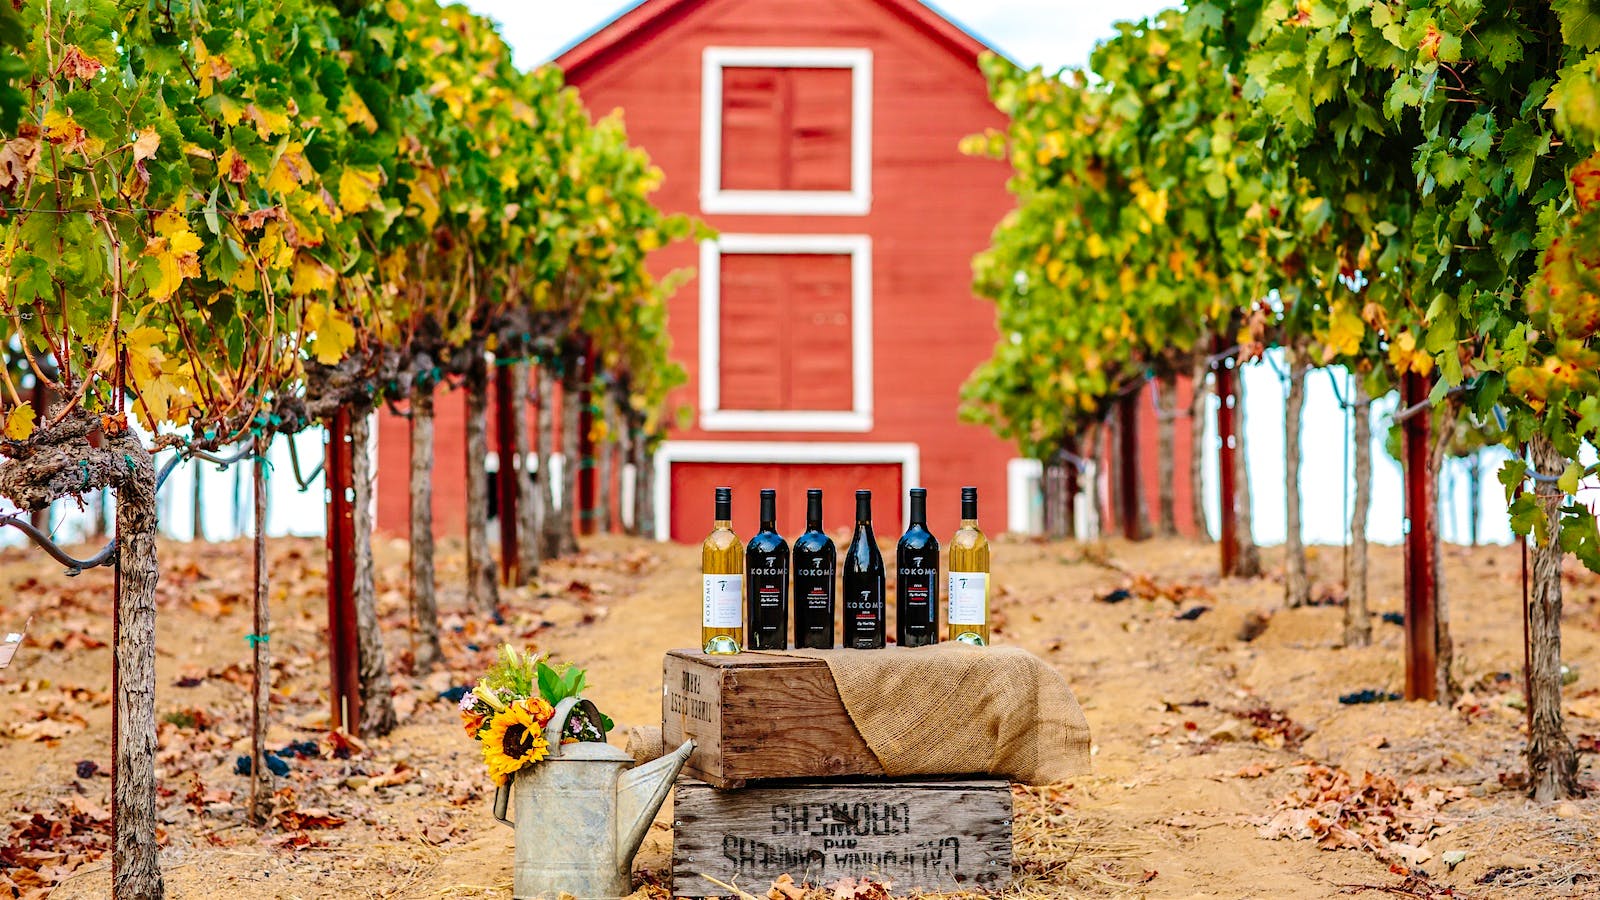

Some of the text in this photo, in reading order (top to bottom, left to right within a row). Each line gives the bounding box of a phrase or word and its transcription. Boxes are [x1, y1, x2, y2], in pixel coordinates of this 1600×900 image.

[750, 567, 788, 576] KOKOMO
[798, 568, 834, 577] KOKOMO
[899, 567, 937, 576] KOKOMO
[846, 601, 884, 610] KOKOMO
[771, 802, 910, 837] GROWERS
